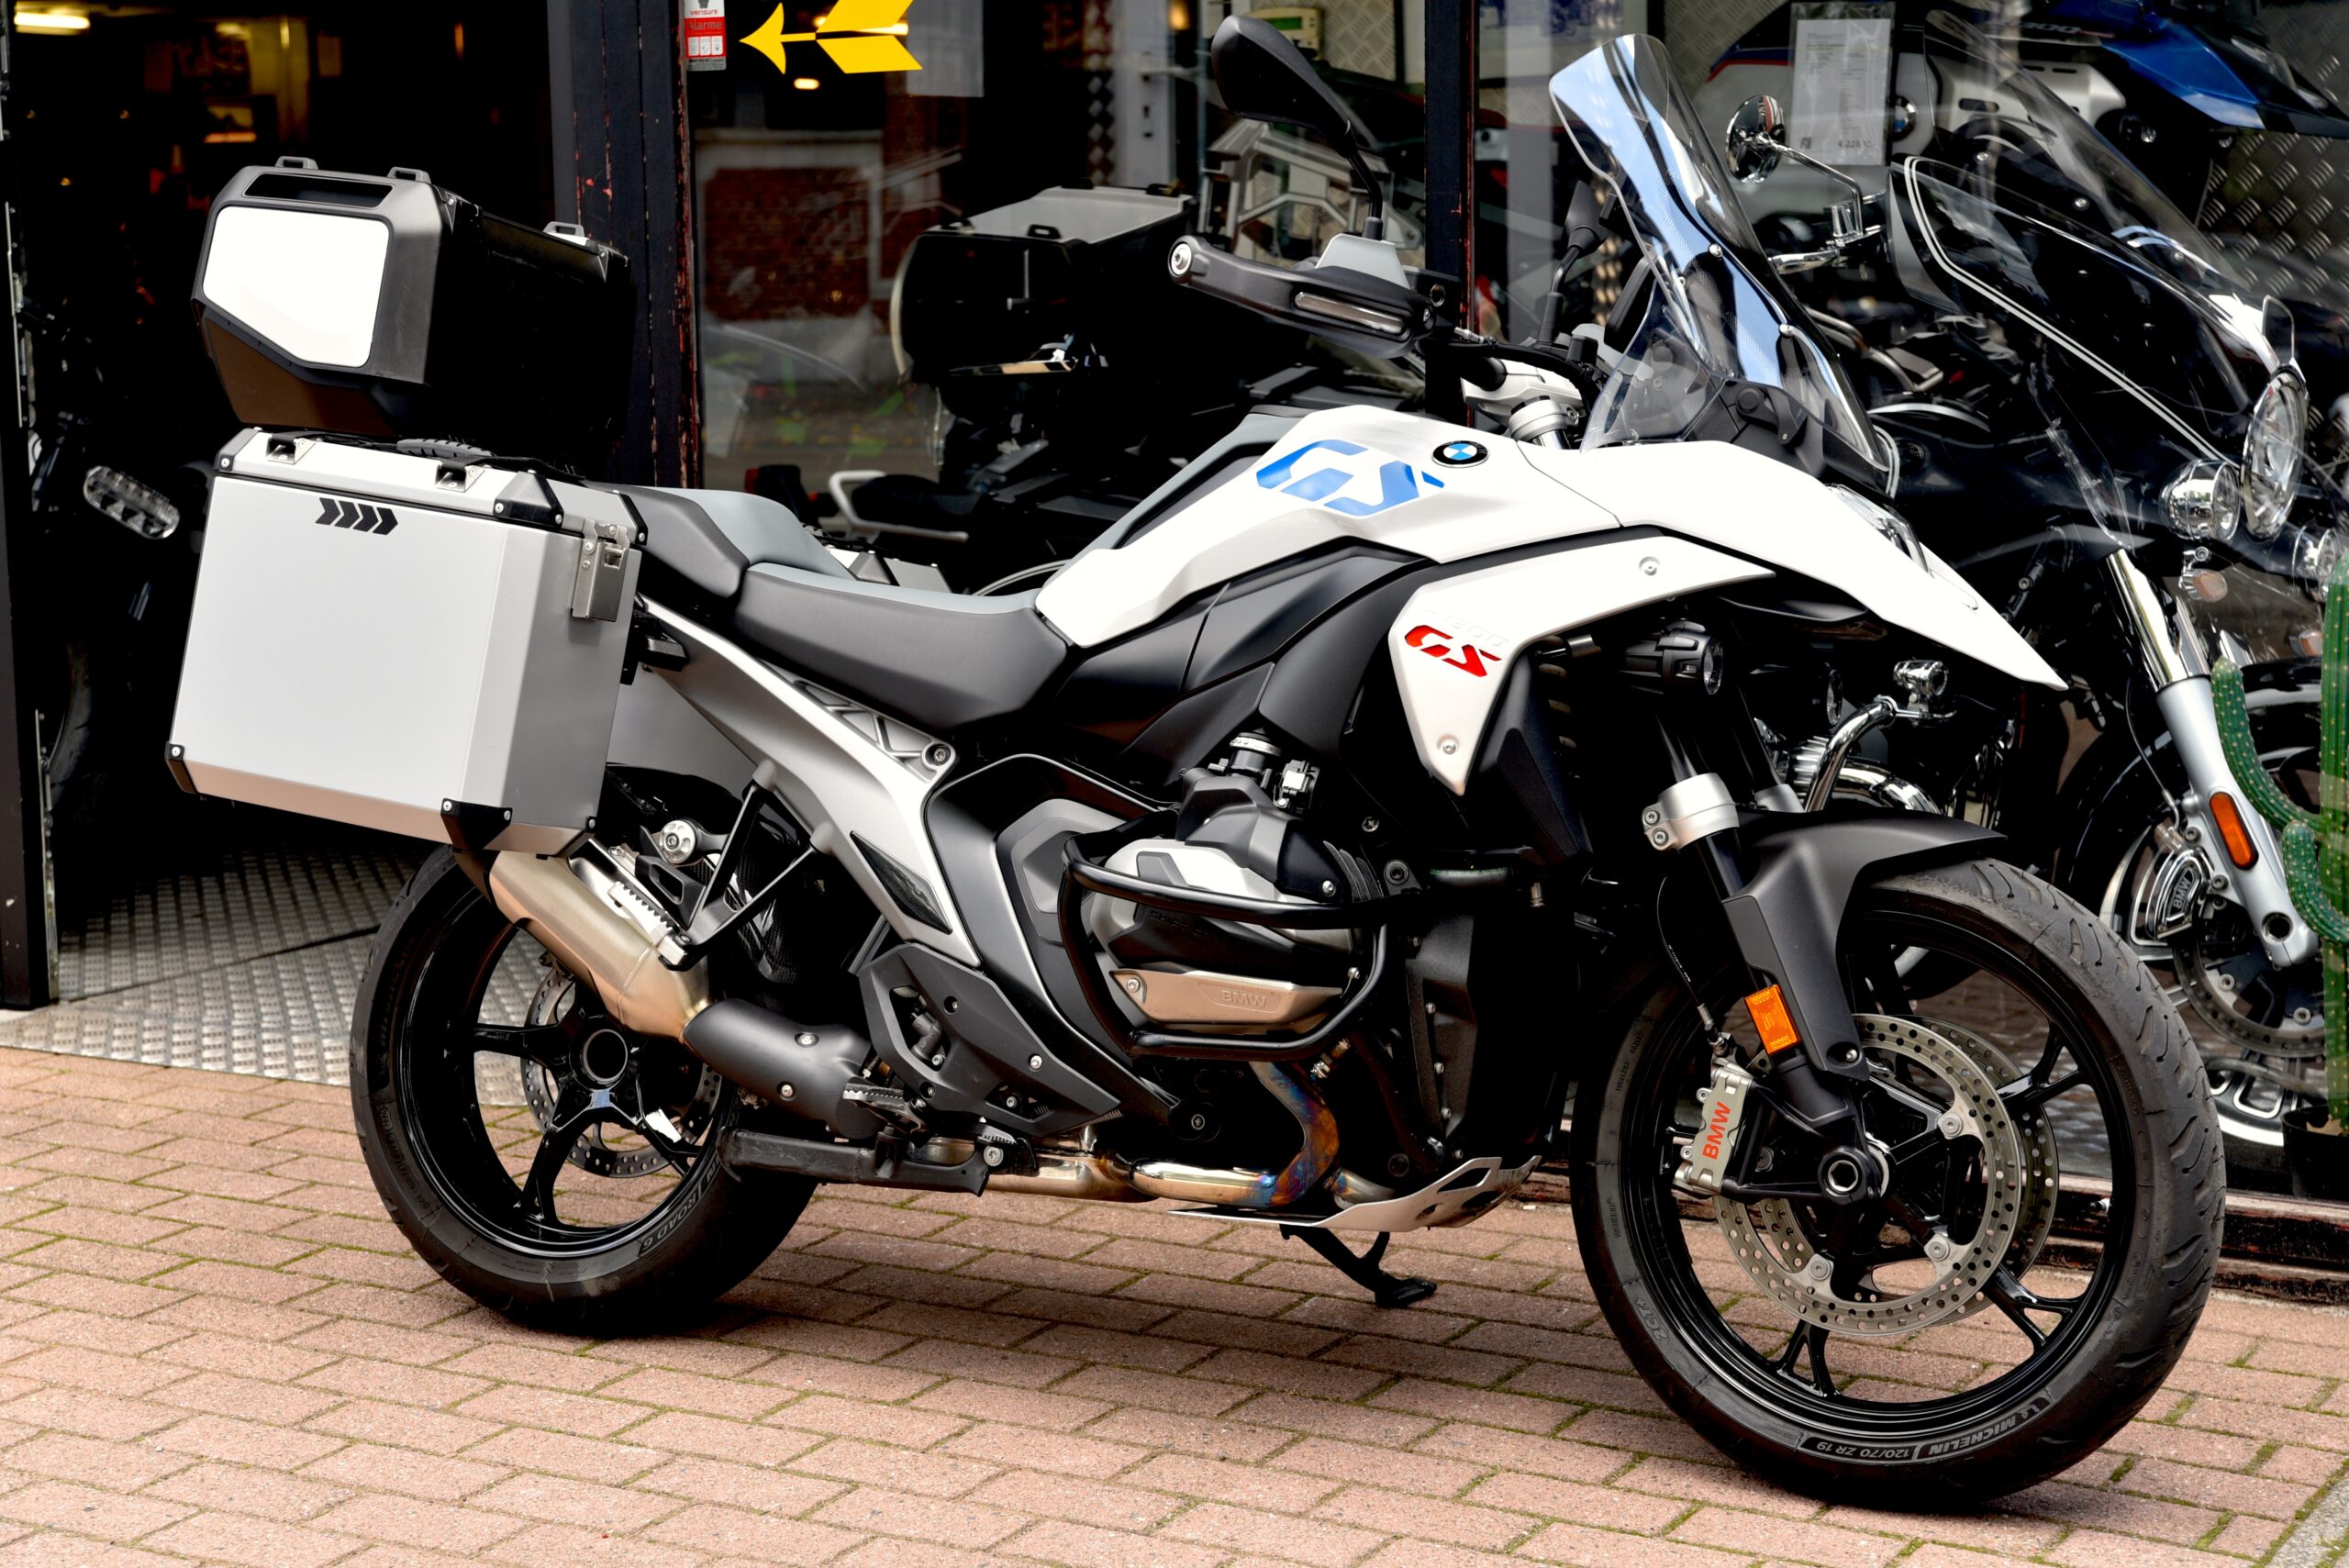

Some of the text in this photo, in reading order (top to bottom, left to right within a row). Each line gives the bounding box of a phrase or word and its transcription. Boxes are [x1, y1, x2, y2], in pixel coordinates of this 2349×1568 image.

[688, 19, 722, 30] Alarme
[1256, 439, 1445, 517] GS
[1404, 624, 1503, 678] GS
[2172, 875, 2192, 910] BMW
[1220, 988, 1267, 1008] BMW
[1702, 1100, 1731, 1161] BMW
[644, 1193, 696, 1249] ROAD 6
[1816, 1440, 1910, 1459] 120/70 ZR 19
[1928, 1415, 2018, 1456] MICHELIN
